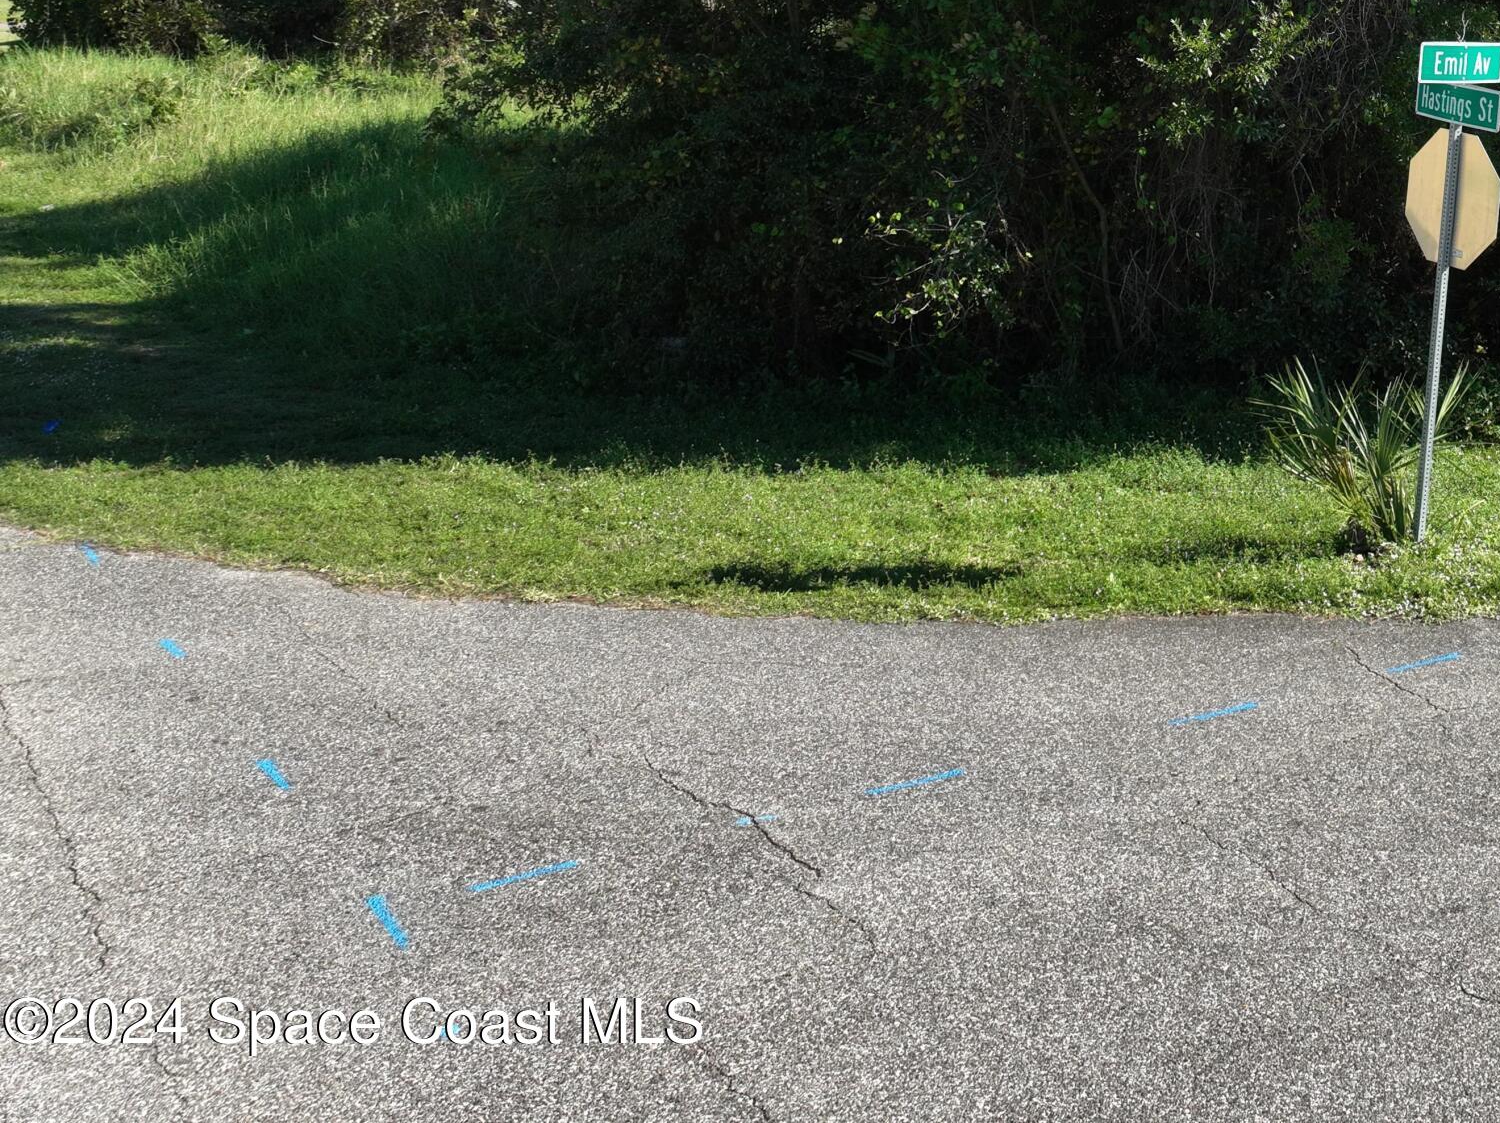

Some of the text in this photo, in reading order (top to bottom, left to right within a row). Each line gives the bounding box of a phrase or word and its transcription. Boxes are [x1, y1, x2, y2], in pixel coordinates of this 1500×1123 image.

[1434, 51, 1491, 76] Emil Av
[1421, 85, 1494, 123] Hastings St
